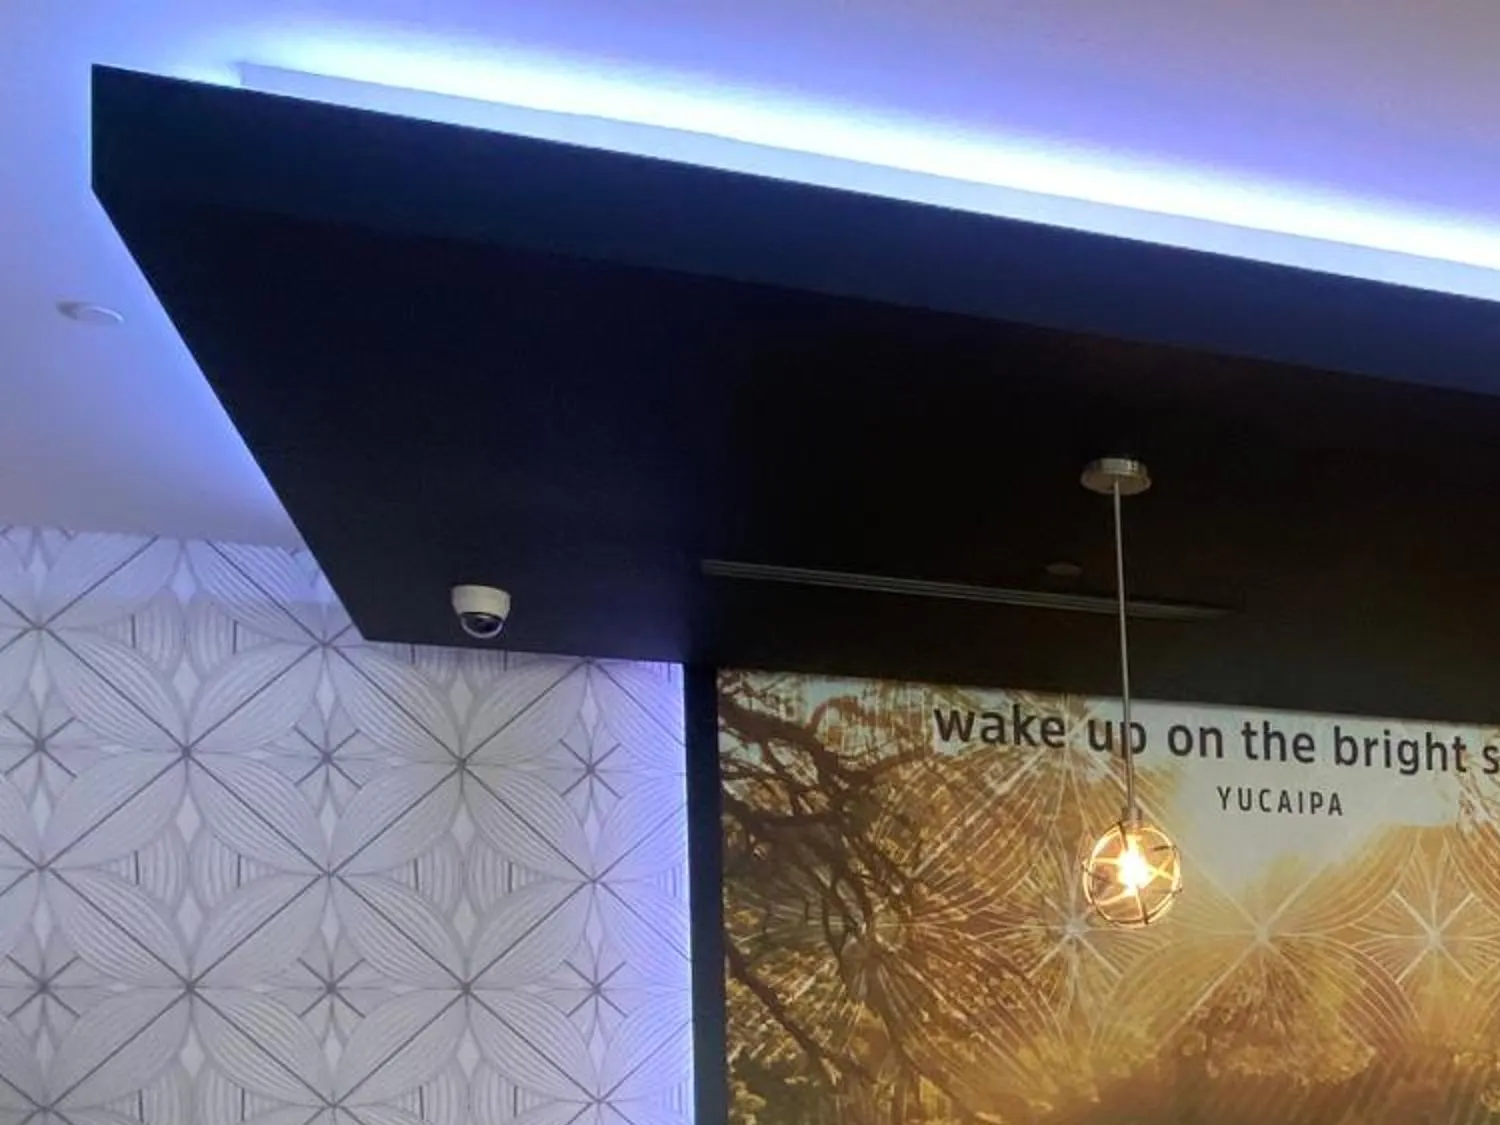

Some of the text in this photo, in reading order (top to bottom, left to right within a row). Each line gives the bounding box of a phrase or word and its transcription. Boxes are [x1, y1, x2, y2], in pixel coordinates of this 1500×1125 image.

[933, 703, 1066, 749] wake
[1088, 719, 1147, 760] up
[1167, 724, 1223, 759] on
[1241, 721, 1316, 763] the
[1334, 725, 1467, 775] bright
[1216, 785, 1343, 817] YUCAIPA
